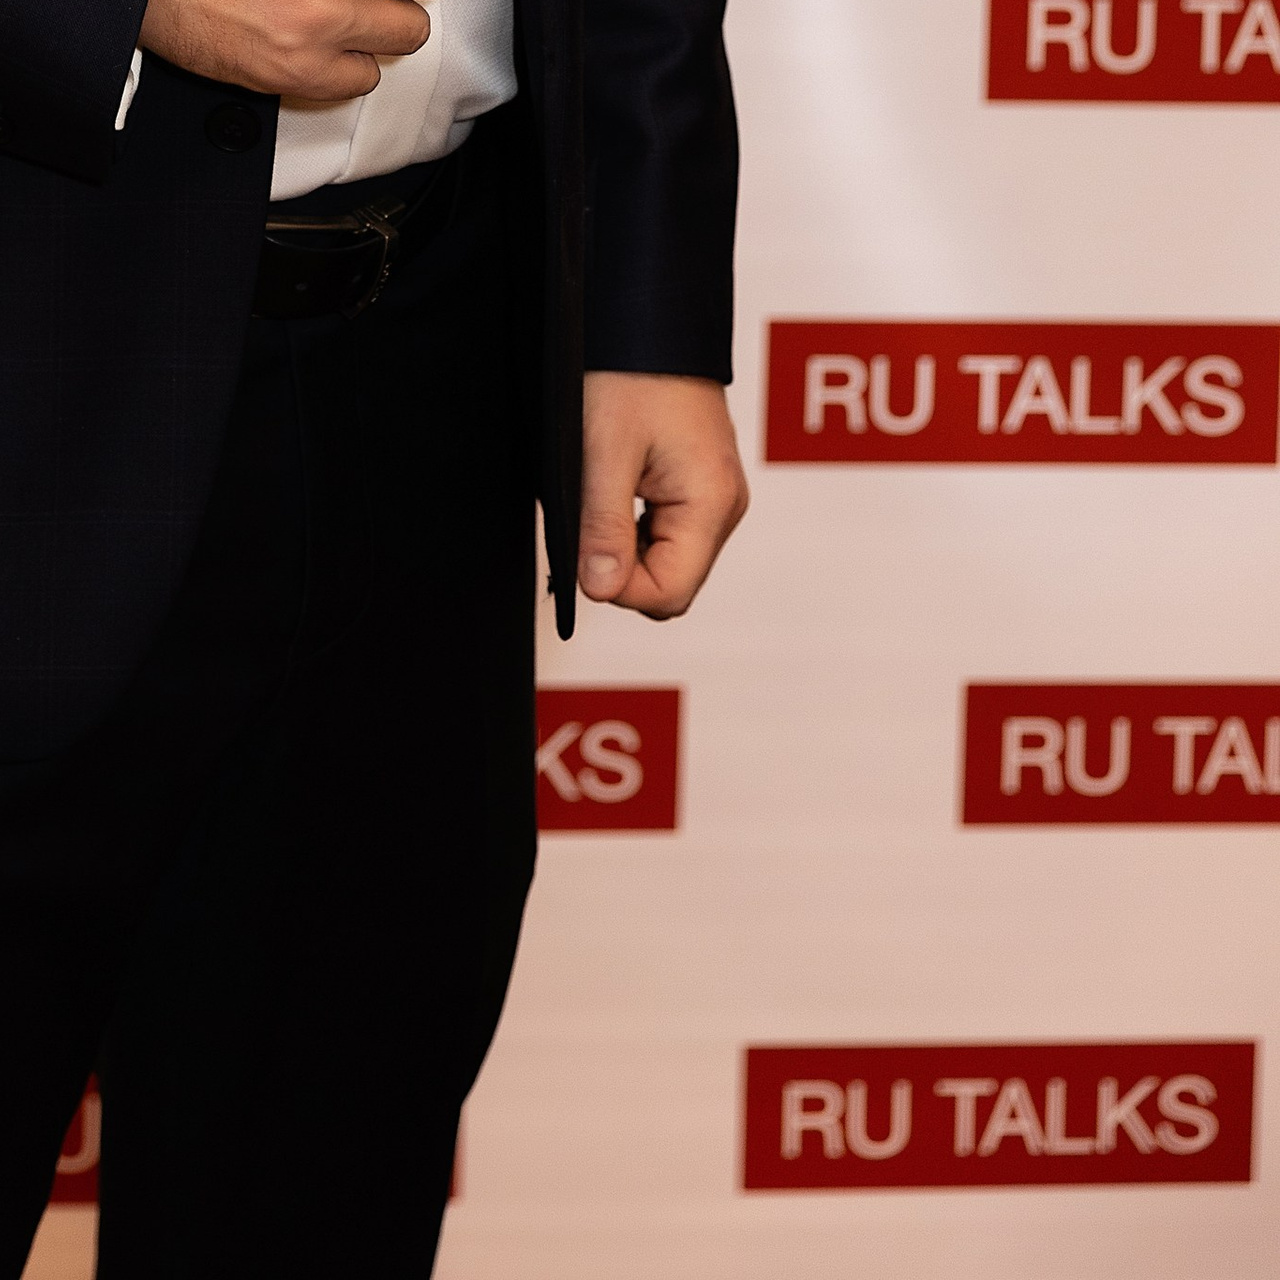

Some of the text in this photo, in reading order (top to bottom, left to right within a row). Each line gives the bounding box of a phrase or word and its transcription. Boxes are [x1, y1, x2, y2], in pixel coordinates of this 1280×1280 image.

[803, 352, 1246, 439] RU TALKS
[999, 715, 1132, 797] RU
[781, 1075, 1220, 1161] RU TALKS
